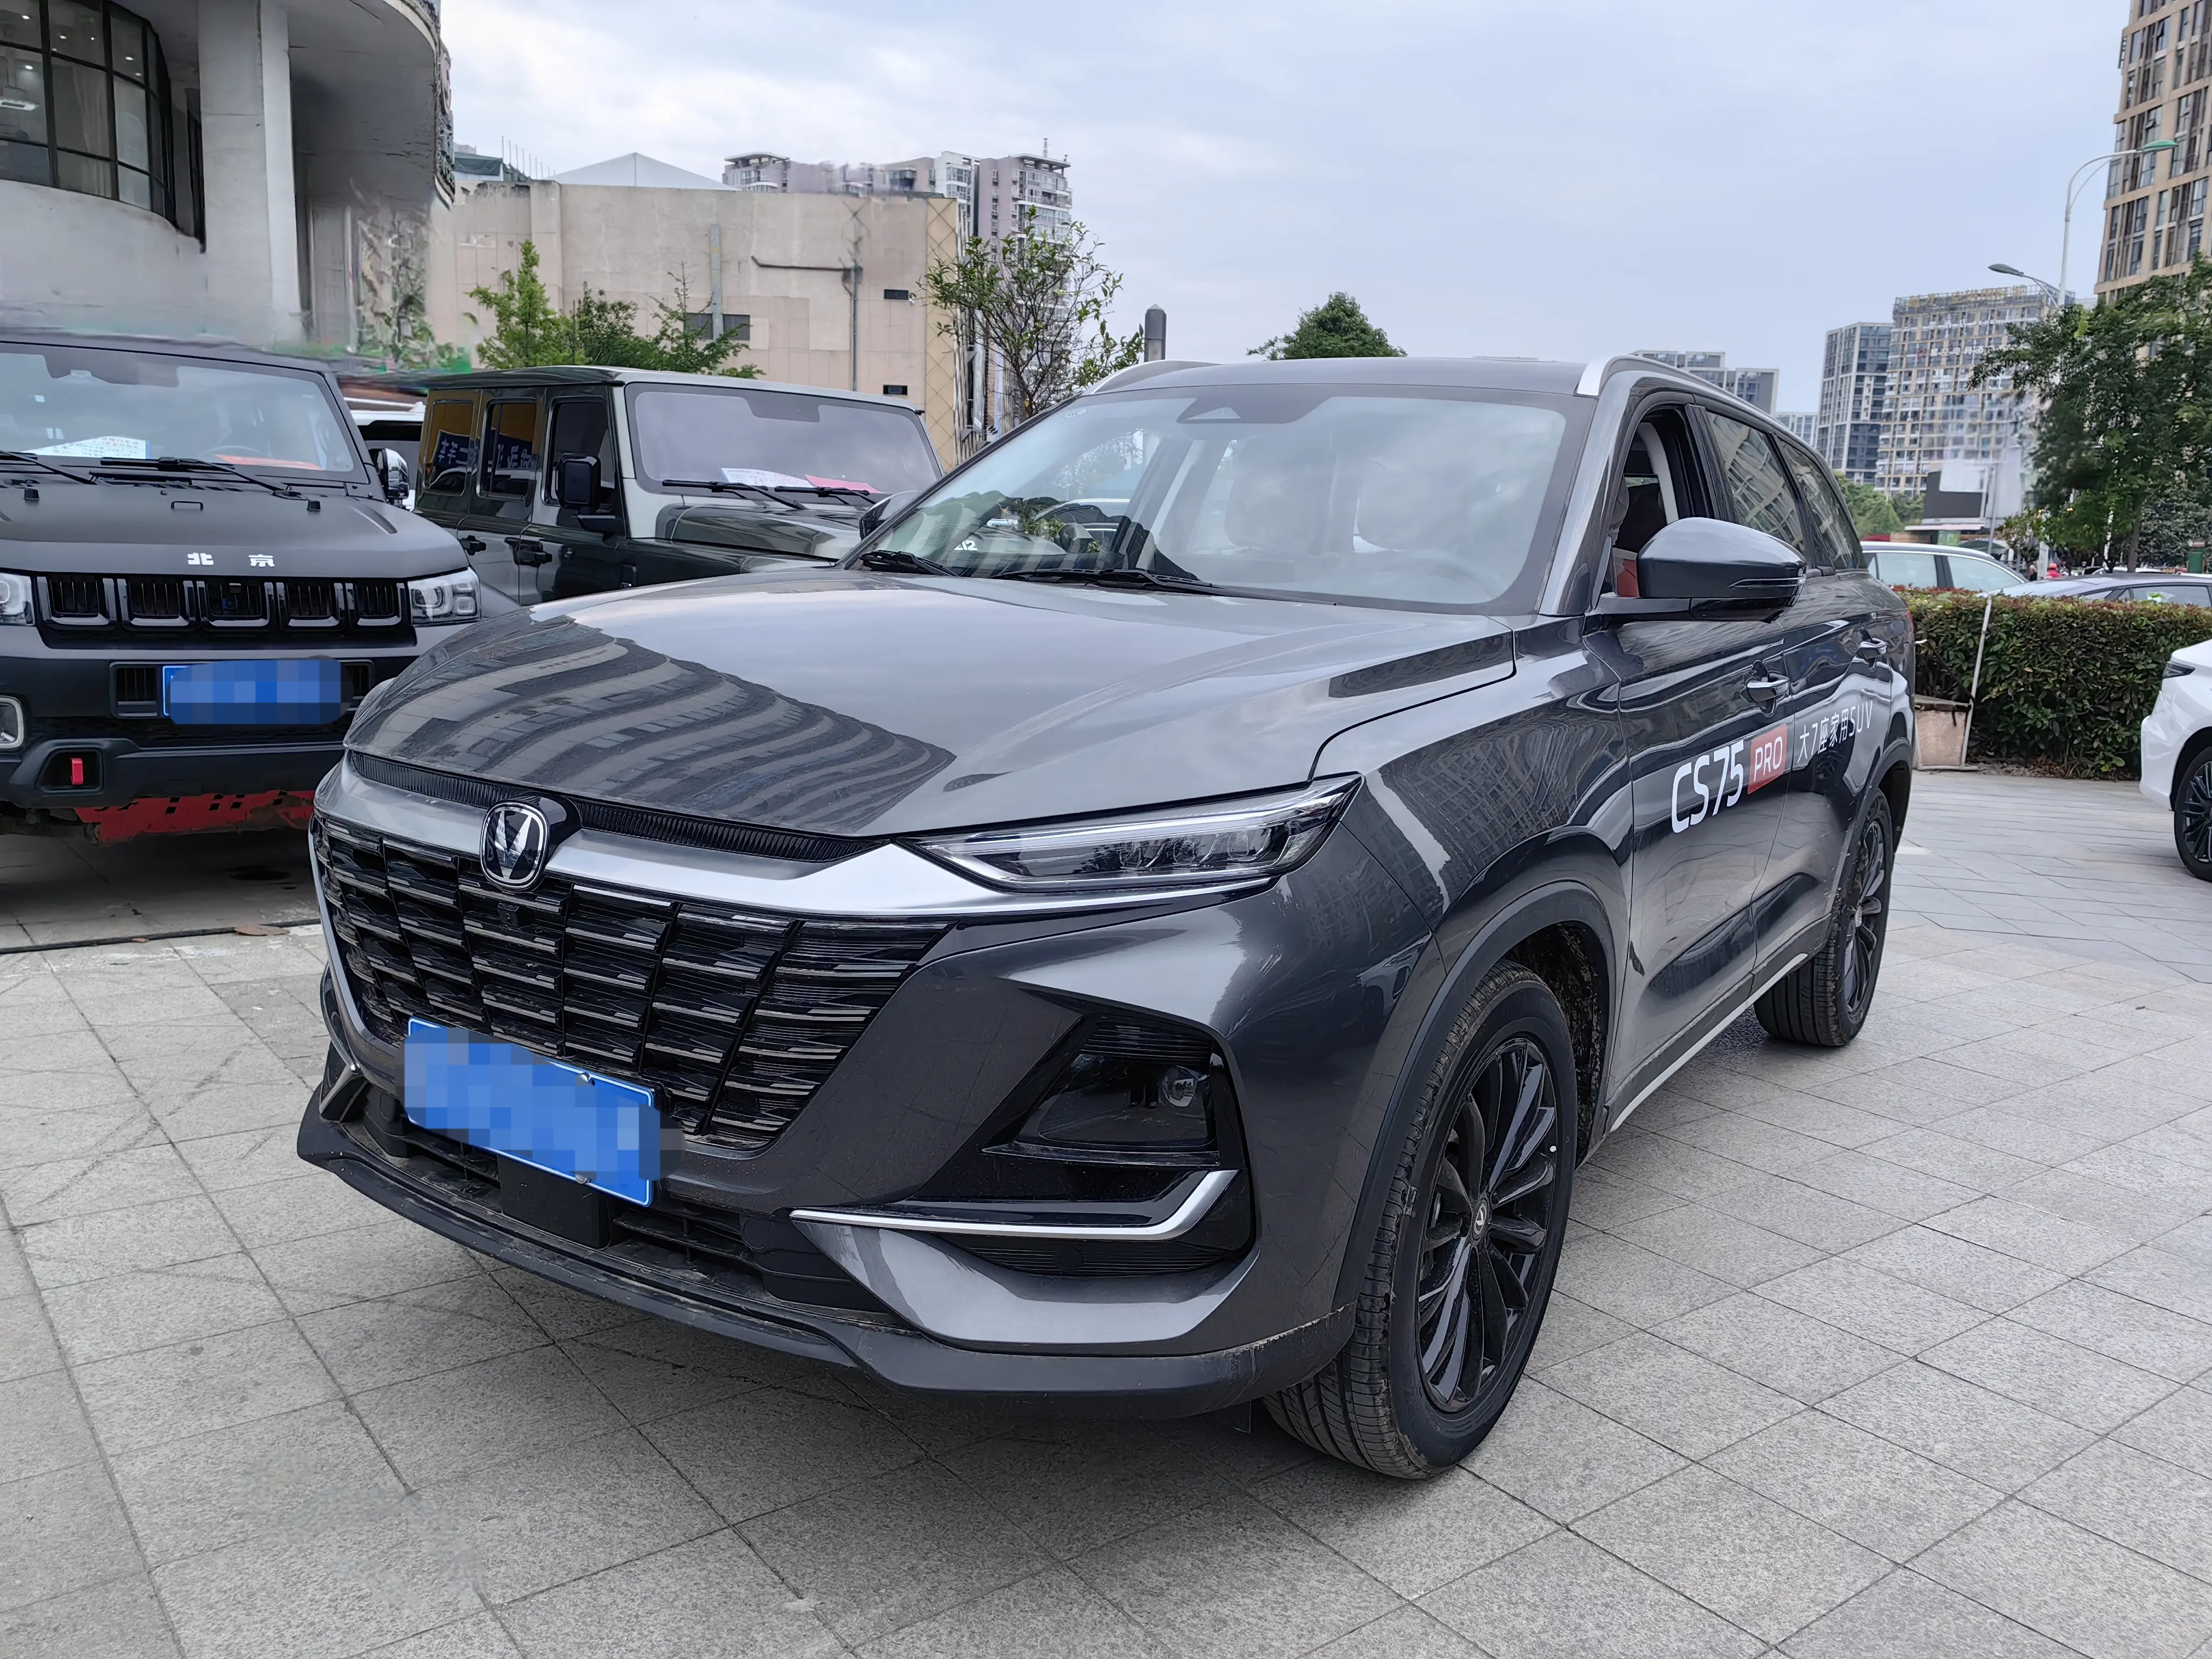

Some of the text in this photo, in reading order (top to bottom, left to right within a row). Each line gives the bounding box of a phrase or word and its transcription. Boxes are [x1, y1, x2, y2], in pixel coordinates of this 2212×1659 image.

[187, 552, 275, 567] 北京
[1797, 700, 1873, 764] 大7座家用SUV
[1672, 736, 1783, 833] CS75 PRO
